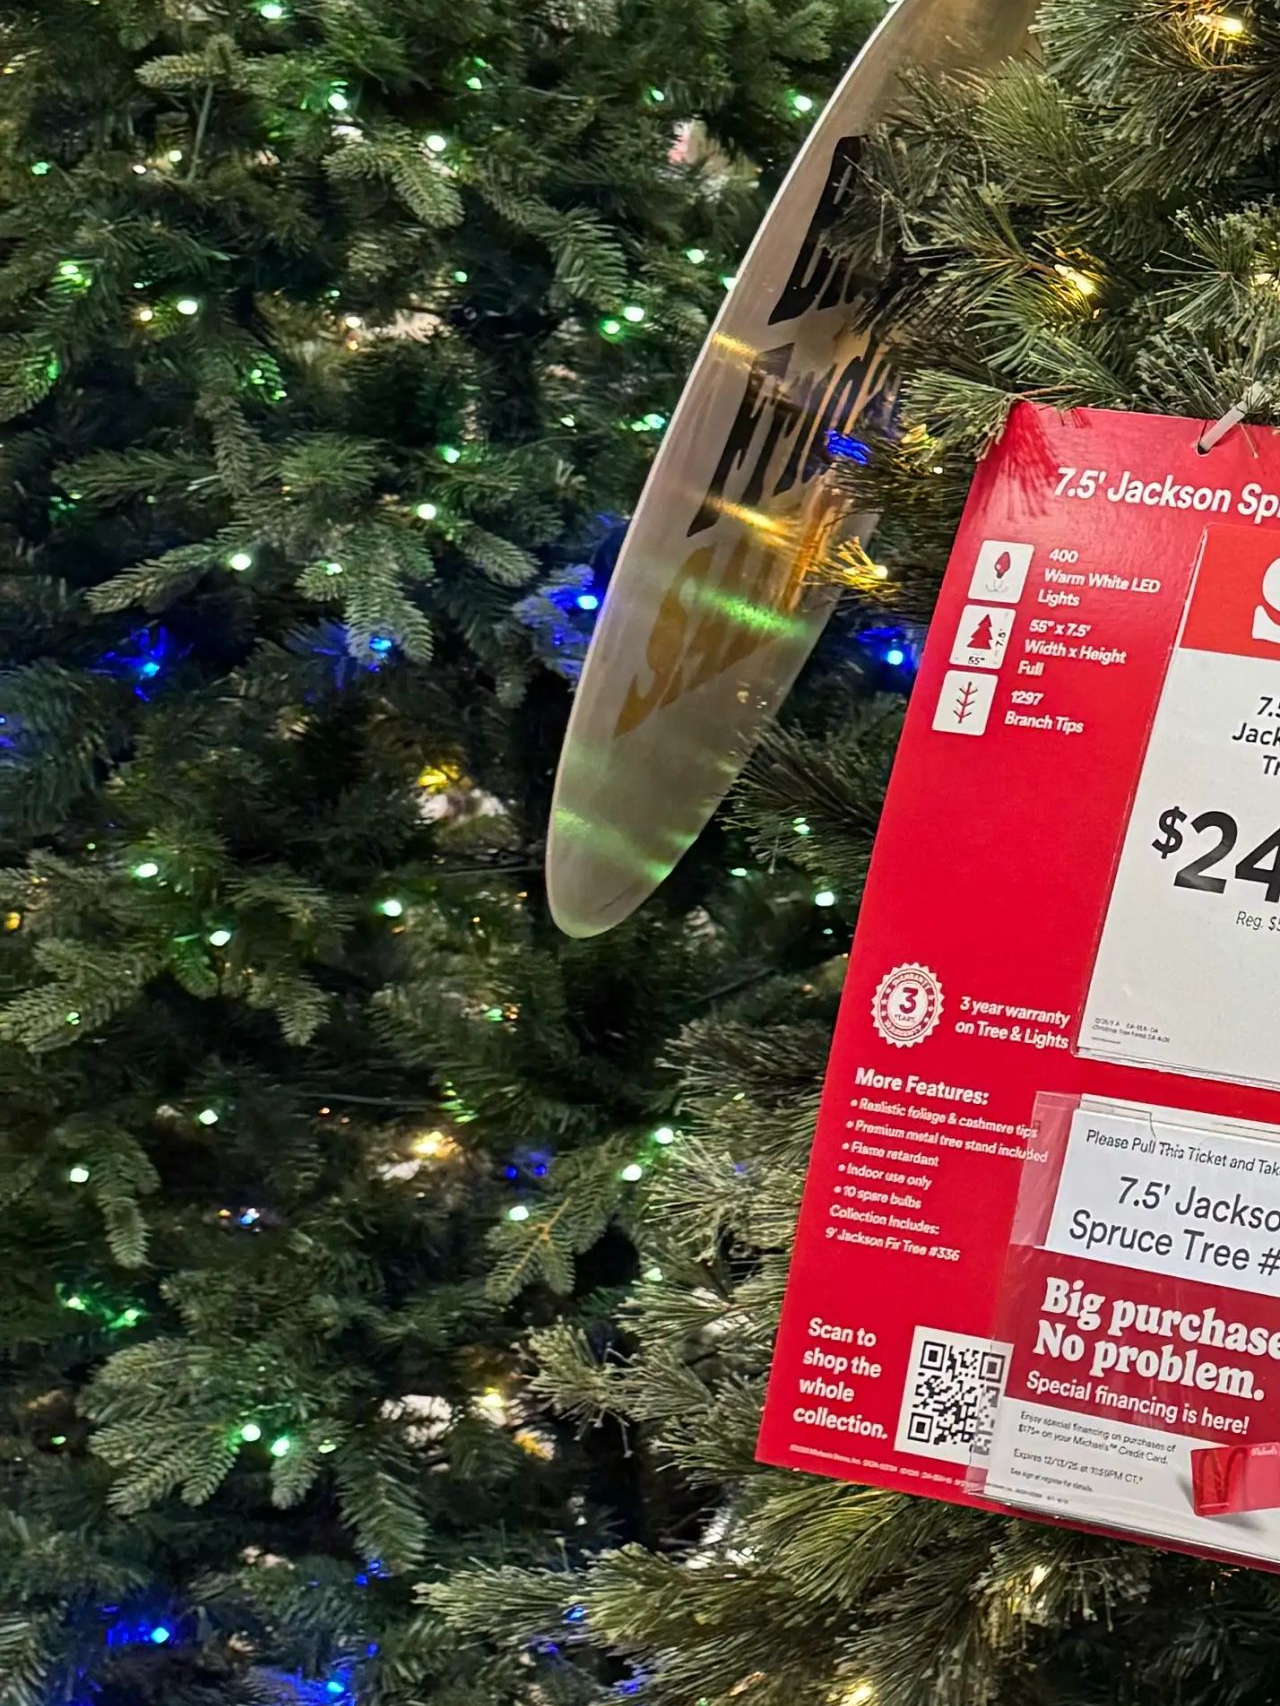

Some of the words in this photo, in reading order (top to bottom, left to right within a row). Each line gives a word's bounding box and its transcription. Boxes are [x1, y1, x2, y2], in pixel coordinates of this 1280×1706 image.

[1050, 466, 1107, 499] 7.5'
[1106, 470, 1232, 513] Jackson
[1048, 547, 1079, 563] 400
[1044, 567, 1086, 586] Warm
[1088, 572, 1130, 590] White
[1130, 576, 1161, 593] LED
[1036, 588, 1080, 608] Lights
[1053, 623, 1065, 635] x
[1016, 659, 1045, 676] Full
[1024, 638, 1067, 657] Width
[1066, 646, 1078, 658] x
[1078, 644, 1127, 666] Height
[1010, 689, 1044, 706] 1297
[1003, 709, 1053, 730] Branch
[1054, 715, 1084, 735] Tips
[1234, 909, 1264, 931] Reg.
[898, 985, 919, 1015] 3
[959, 995, 971, 1011] 3
[970, 999, 1005, 1016] year
[1004, 1004, 1071, 1029] warranty
[954, 1020, 975, 1035] on
[976, 1019, 1009, 1040] Tree
[1008, 1025, 1022, 1042] &
[1023, 1027, 1069, 1049] Lights
[854, 1066, 903, 1091] More
[904, 1074, 990, 1106] Features:
[1085, 1128, 1129, 1150] Please
[1130, 1136, 1157, 1155] Pull
[1158, 1140, 1185, 1160] This
[1187, 1145, 1228, 1167] Ticket
[1228, 1157, 1256, 1172] and
[1117, 1175, 1171, 1210] 7.5'
[1068, 1208, 1173, 1256] Spruce
[1182, 1228, 1250, 1271] Tree
[1037, 1276, 1106, 1331] Big
[807, 1316, 854, 1343] Scan
[856, 1327, 877, 1348] to
[802, 1346, 848, 1375] shop
[850, 1355, 882, 1378] the
[1034, 1320, 1085, 1362] No
[1088, 1329, 1265, 1401] problem.
[798, 1376, 855, 1403] whole
[1025, 1369, 1092, 1401] Special
[1094, 1384, 1178, 1424] financing
[1181, 1402, 1198, 1424] is
[1200, 1405, 1250, 1435] here!
[792, 1405, 888, 1440] collection.
